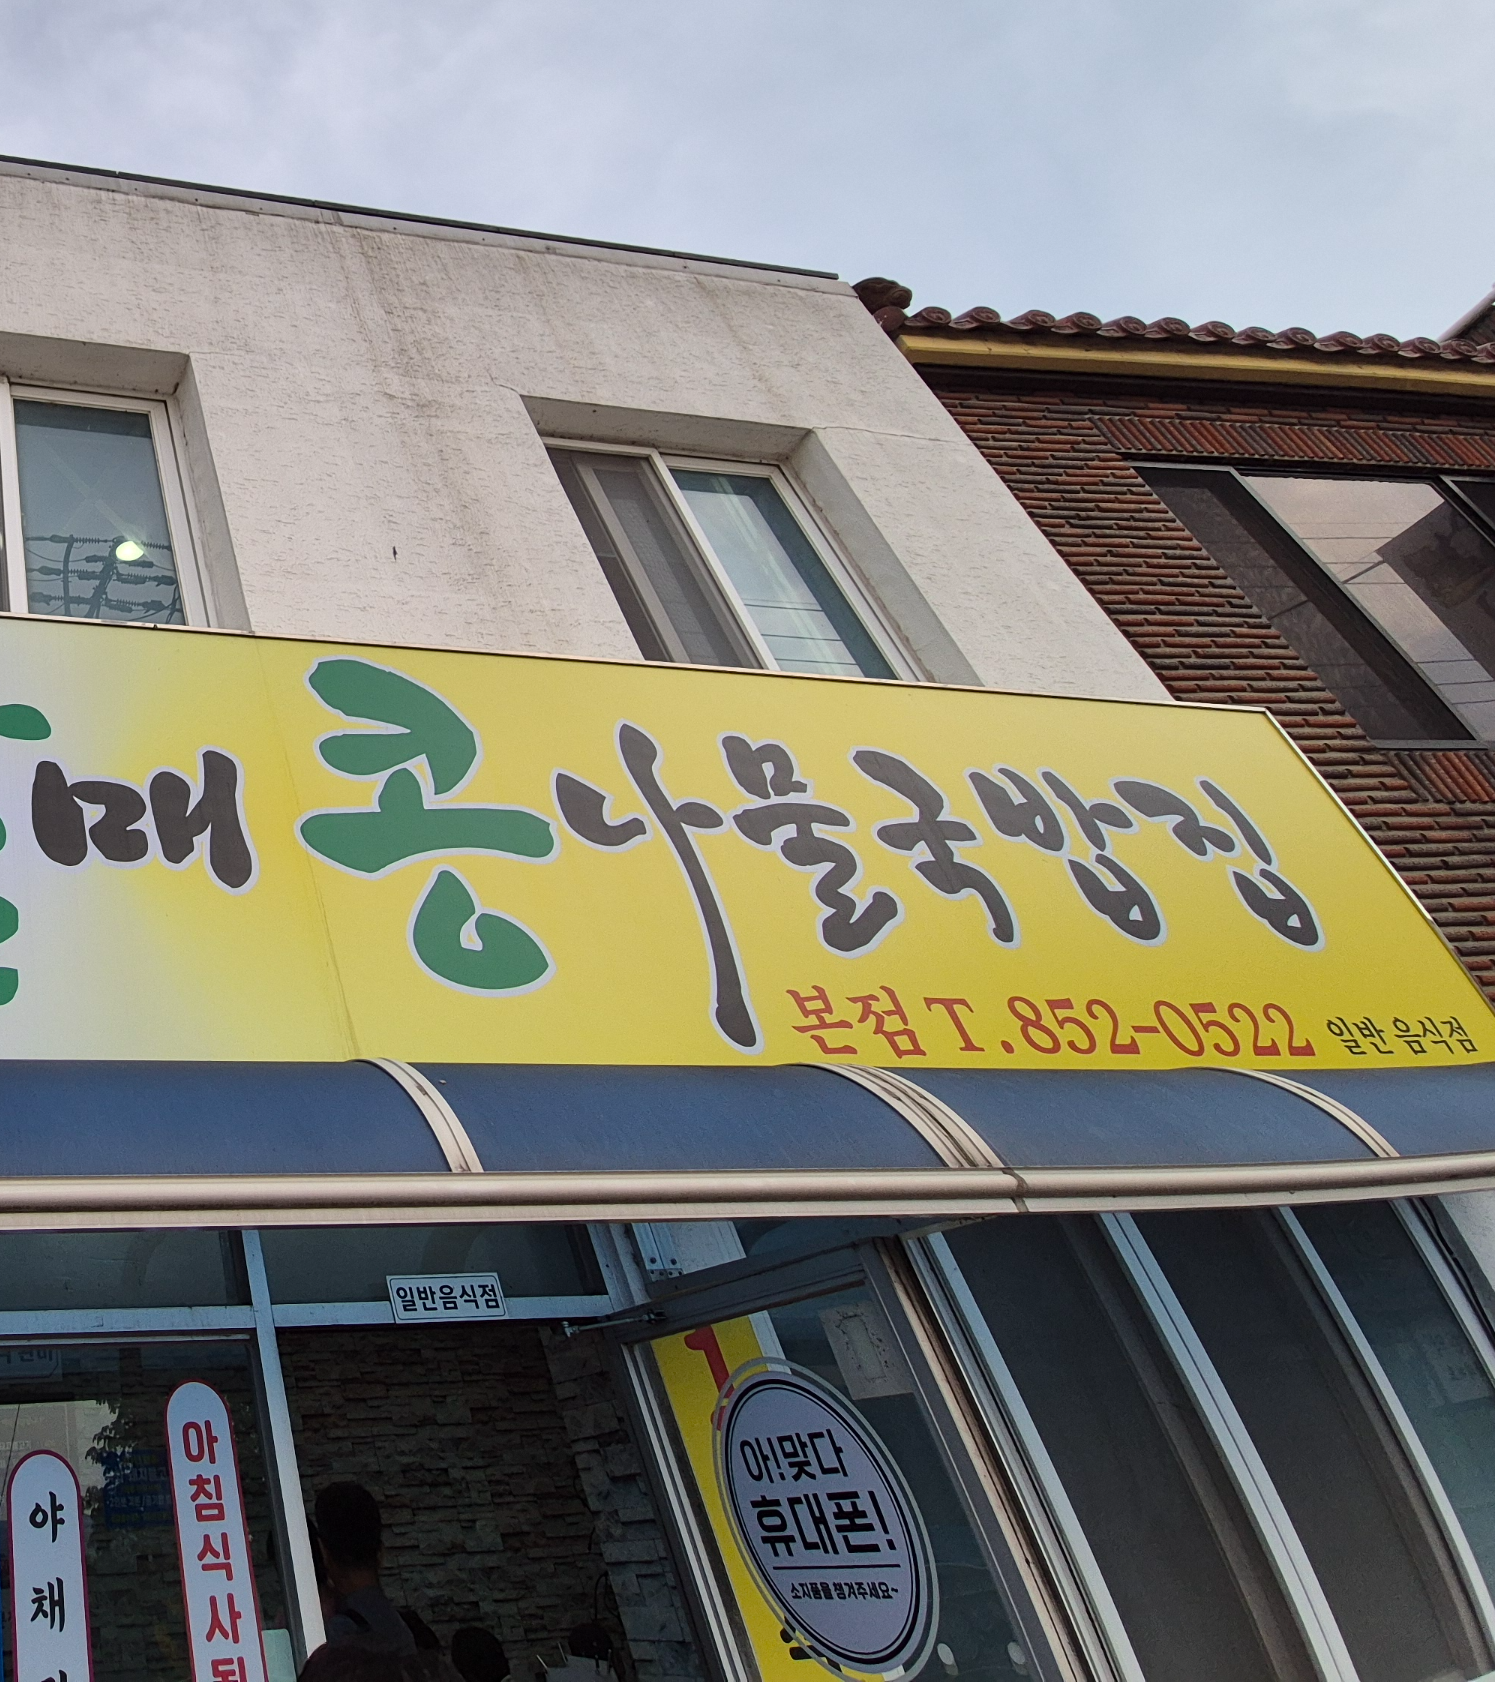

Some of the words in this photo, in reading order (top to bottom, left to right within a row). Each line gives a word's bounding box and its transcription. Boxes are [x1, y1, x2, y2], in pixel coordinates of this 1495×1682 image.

[786, 985, 926, 1058] 본점
[395, 1283, 501, 1313] 일반음식점
[750, 1490, 897, 1557] 휴대폰!
[29, 1491, 69, 1682] 야채
